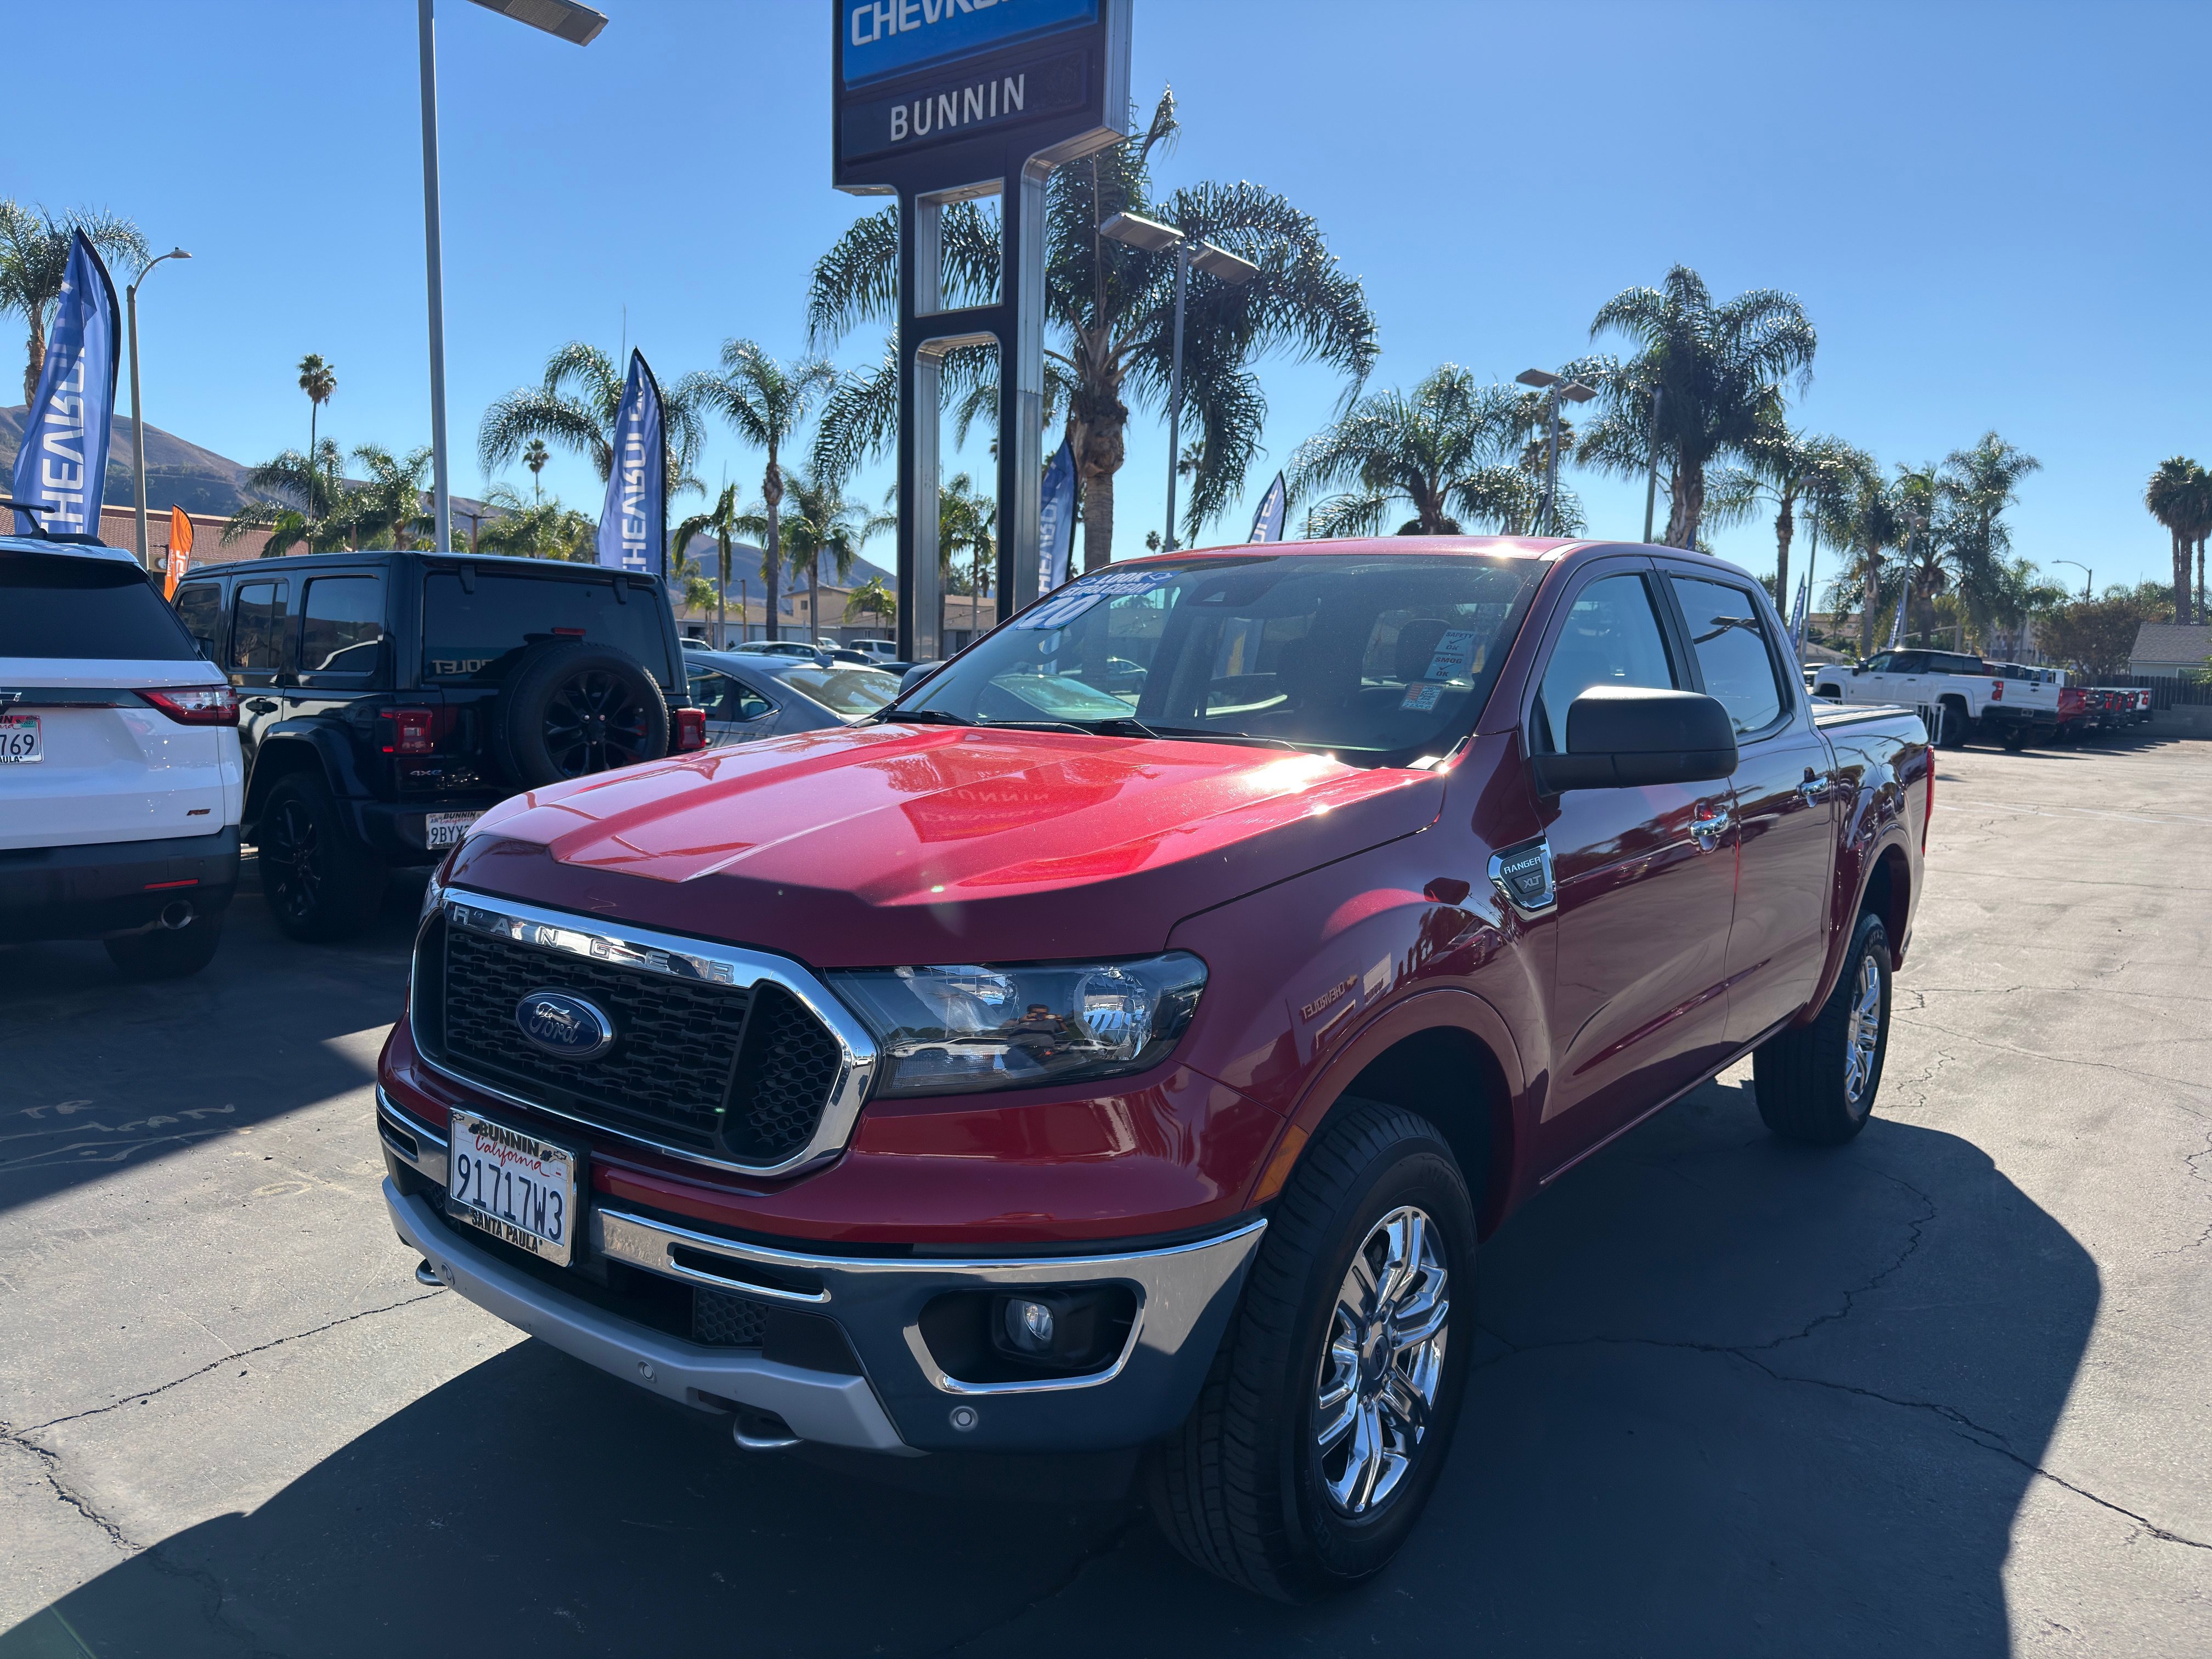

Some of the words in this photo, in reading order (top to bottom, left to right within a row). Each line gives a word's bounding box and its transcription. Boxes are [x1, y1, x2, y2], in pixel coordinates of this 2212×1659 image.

[851, 0, 1008, 46] CHEV
[890, 74, 1025, 142] BUNNIN
[1057, 584, 1103, 597] EXTRA
[1094, 572, 1153, 585] LOOK
[1101, 583, 1157, 595] CLEAN
[431, 825, 470, 843] 9BYX
[1504, 856, 1542, 874] RANGER
[1523, 874, 1542, 889] XLT
[453, 905, 735, 985] RANGER
[528, 1001, 582, 1045] Ford
[475, 1135, 550, 1177] California
[479, 1121, 539, 1157] BUNNIN
[456, 1153, 563, 1240] 91717W3
[471, 1210, 503, 1237] SANTA
[506, 1227, 539, 1254] PAULA
